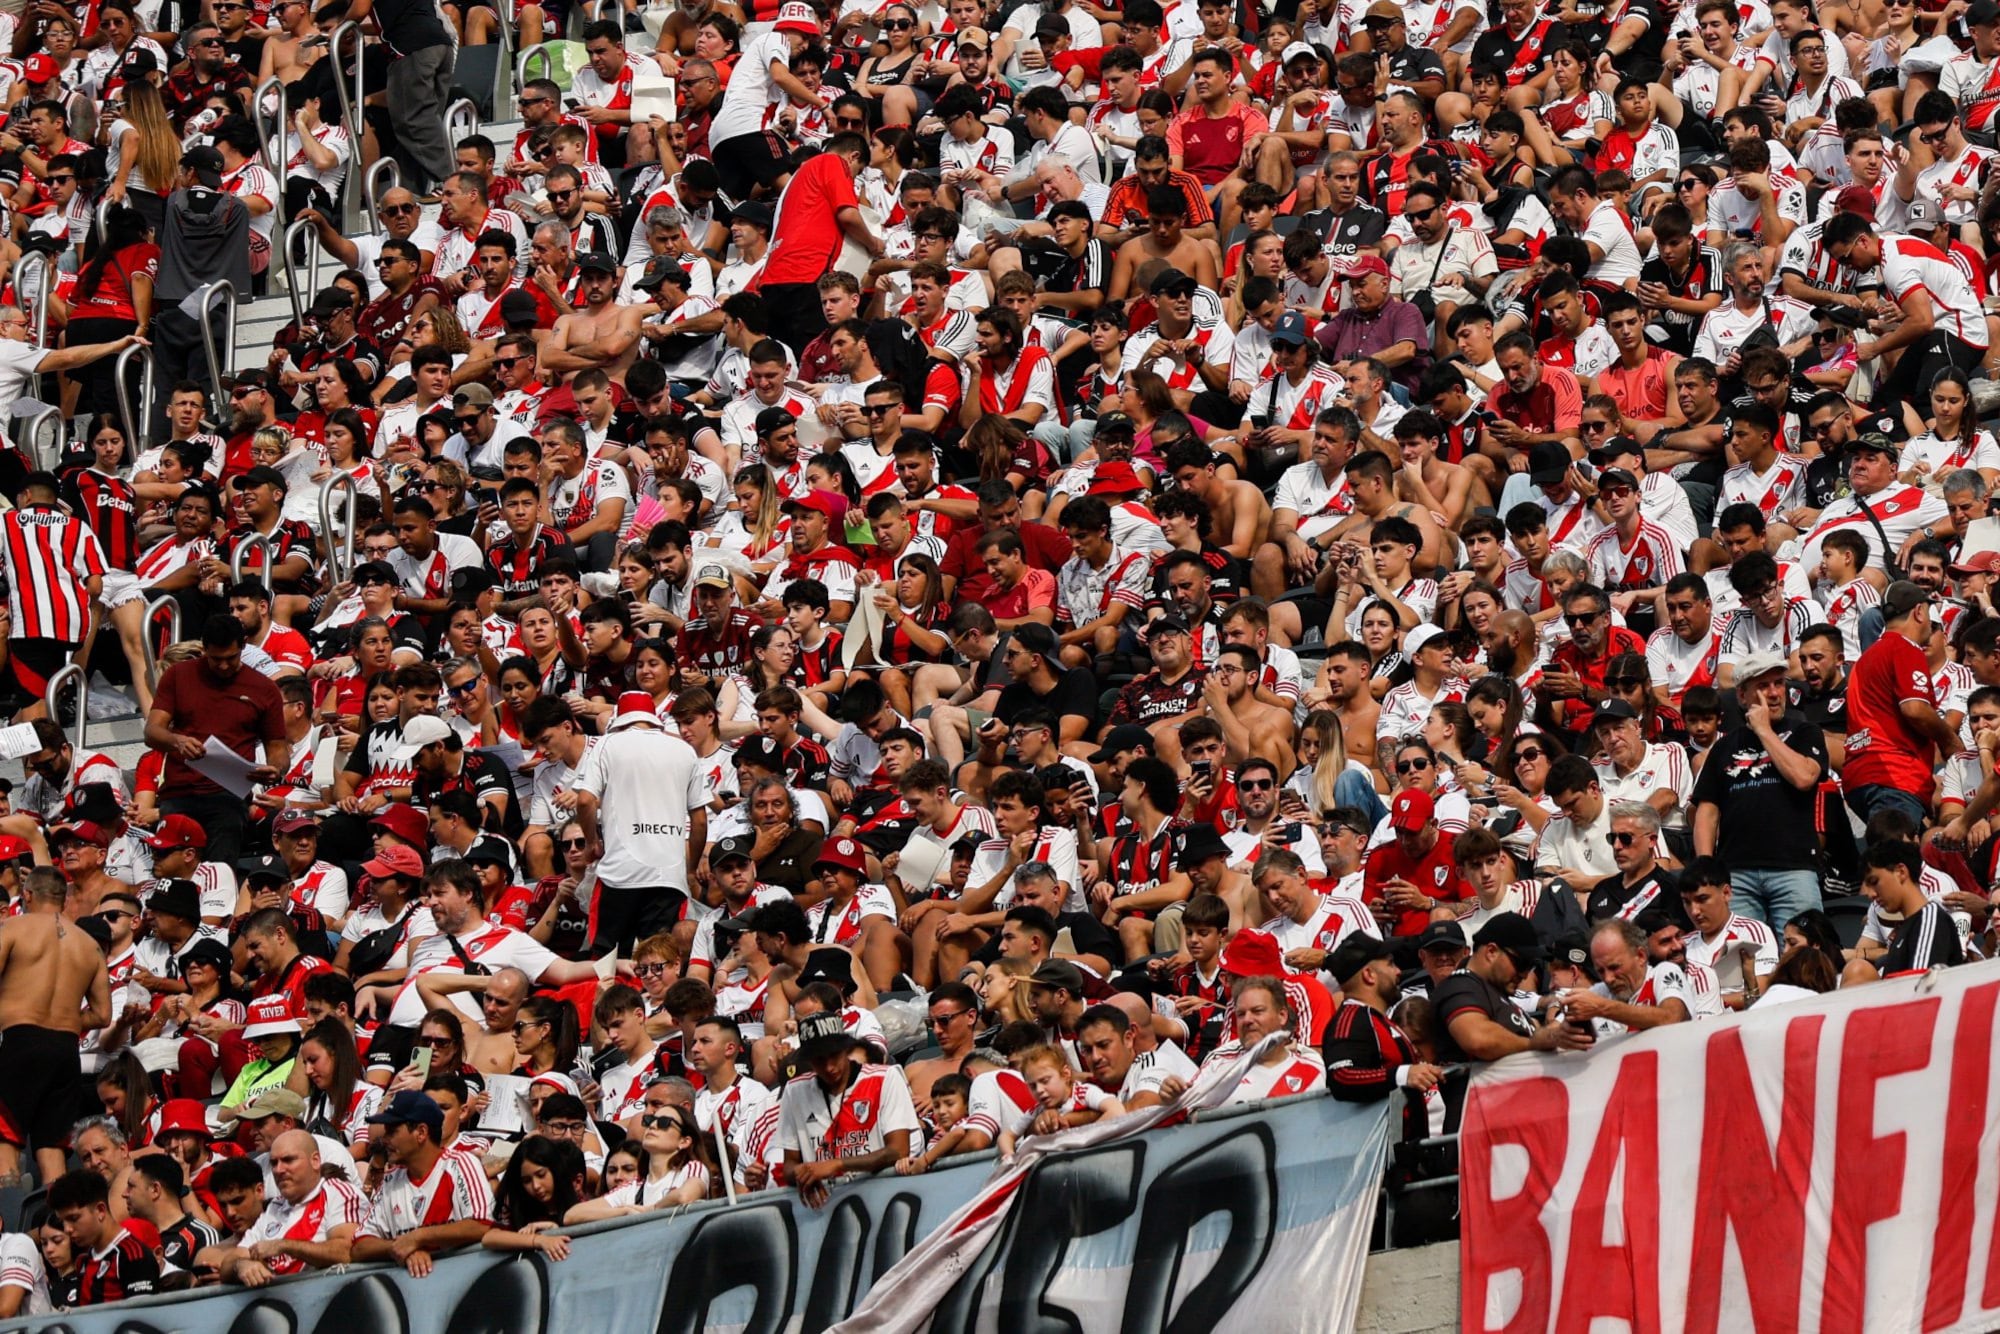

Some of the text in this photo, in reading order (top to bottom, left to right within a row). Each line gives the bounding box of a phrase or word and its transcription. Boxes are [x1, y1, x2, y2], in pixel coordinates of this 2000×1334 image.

[96, 493, 135, 516] Betan
[16, 512, 70, 527] Quilmes
[632, 823, 683, 836] DIRECTV
[259, 1005, 285, 1020] RIVER
[1461, 978, 2000, 1334] BANFI
